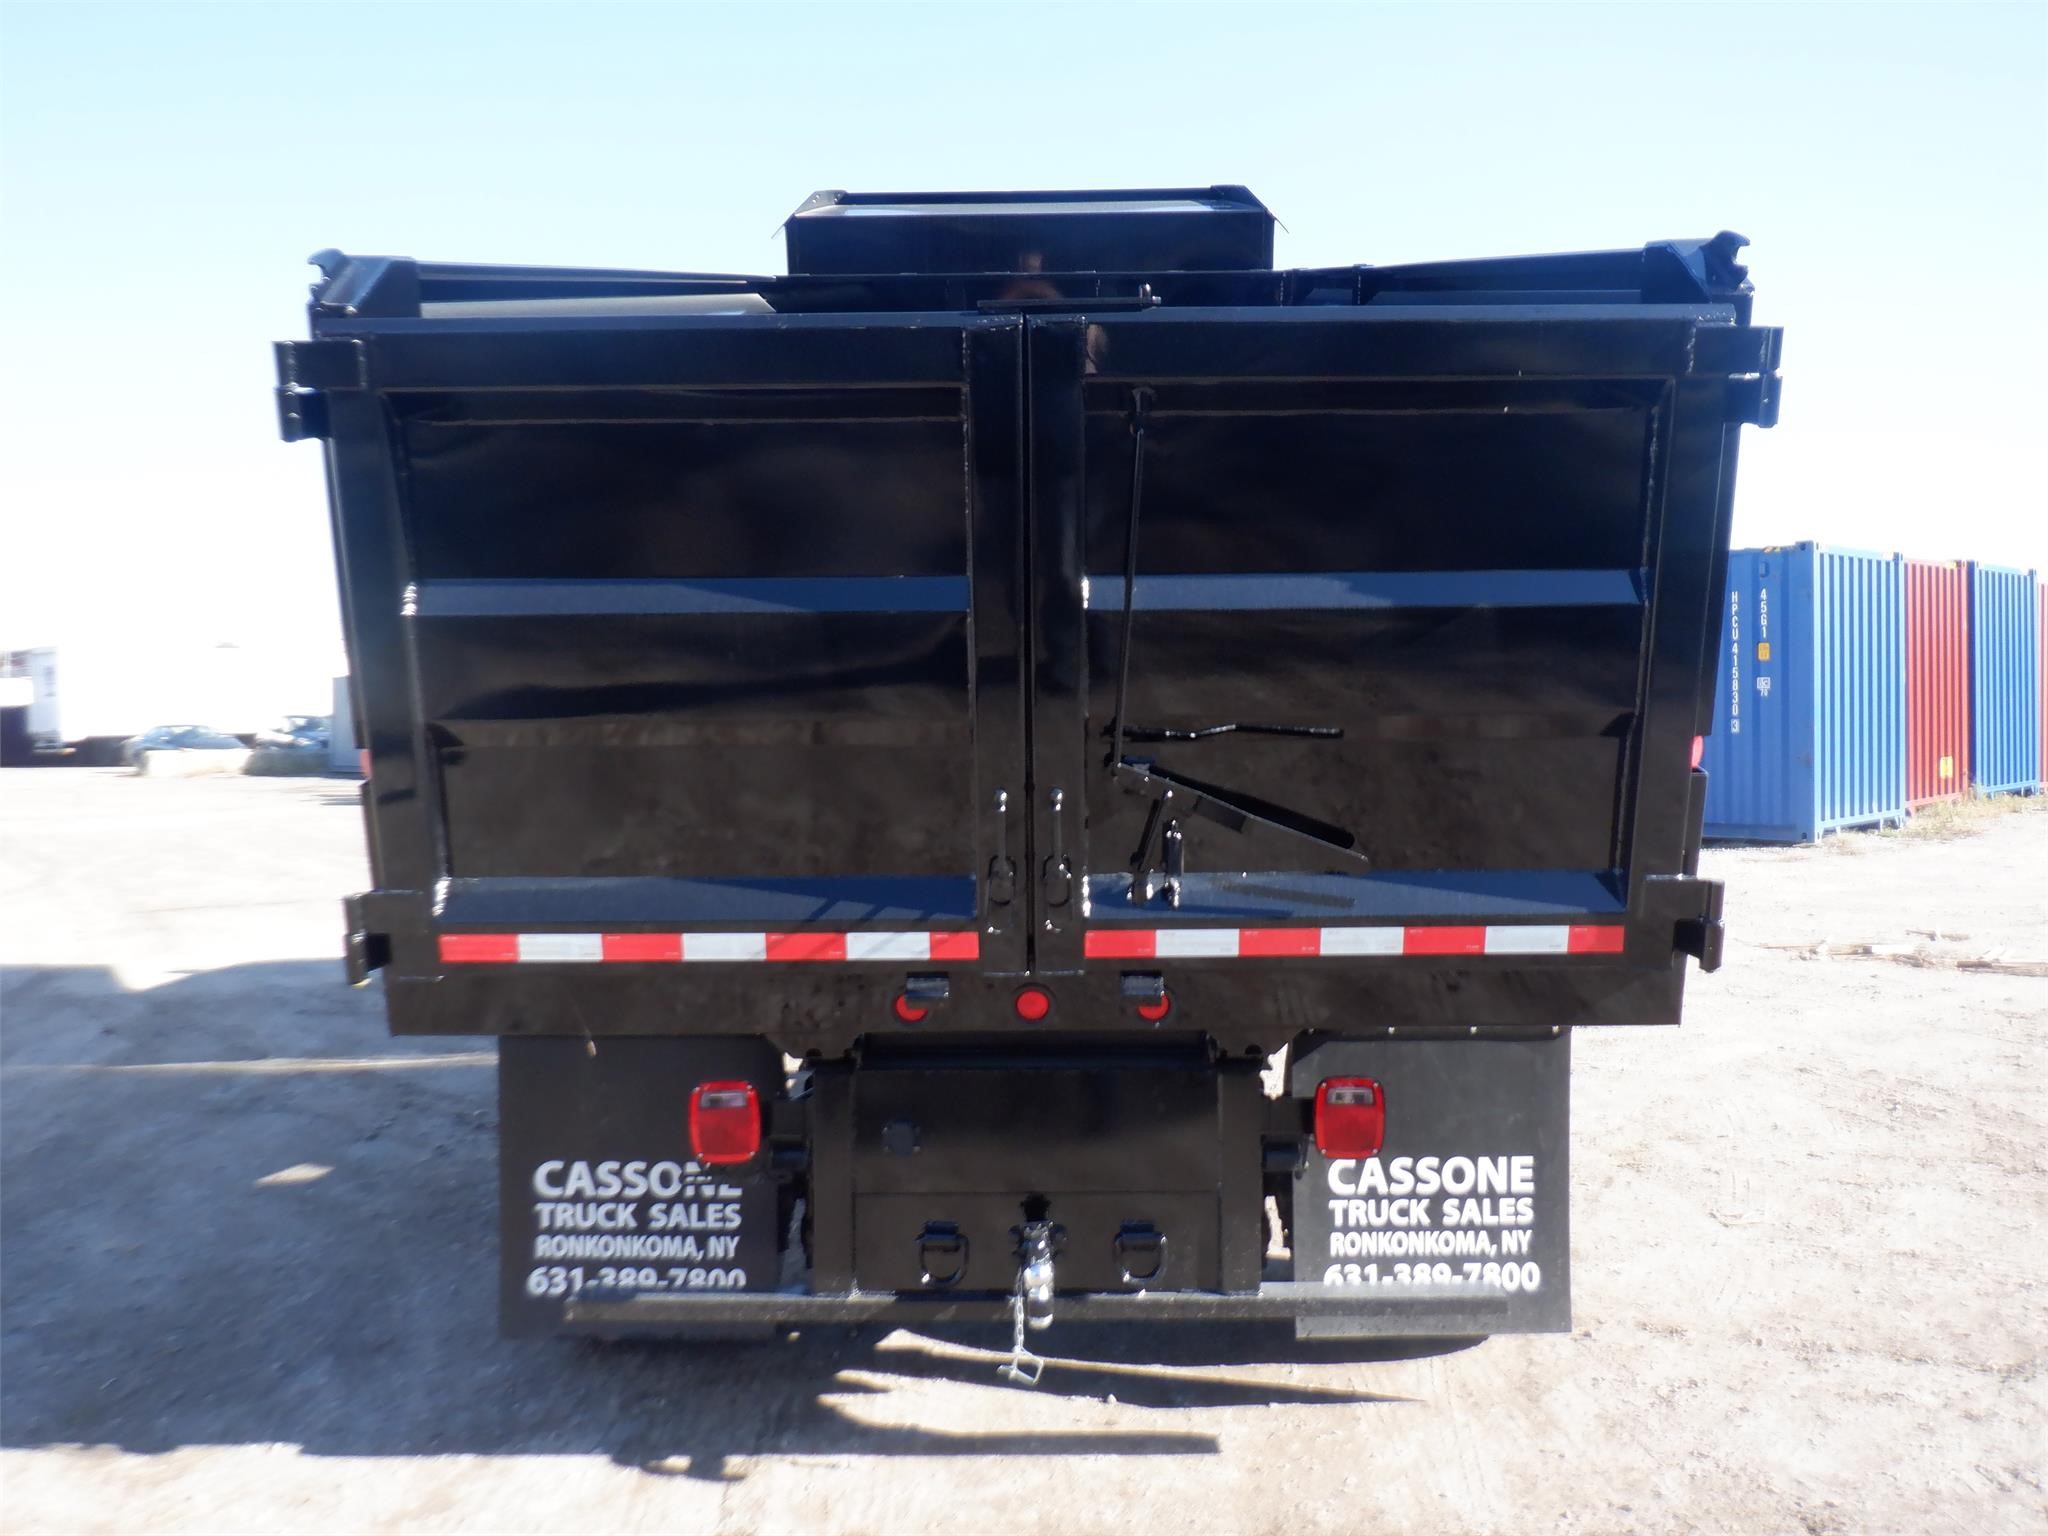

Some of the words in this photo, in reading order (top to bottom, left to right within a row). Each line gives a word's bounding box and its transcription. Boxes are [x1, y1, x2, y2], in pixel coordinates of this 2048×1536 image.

[1328, 1156, 1535, 1195] CASSONE
[534, 1203, 638, 1229] TRUCK
[649, 1203, 742, 1229] SALES
[1328, 1199, 1431, 1227] TRUCK
[1442, 1198, 1534, 1226] SALES
